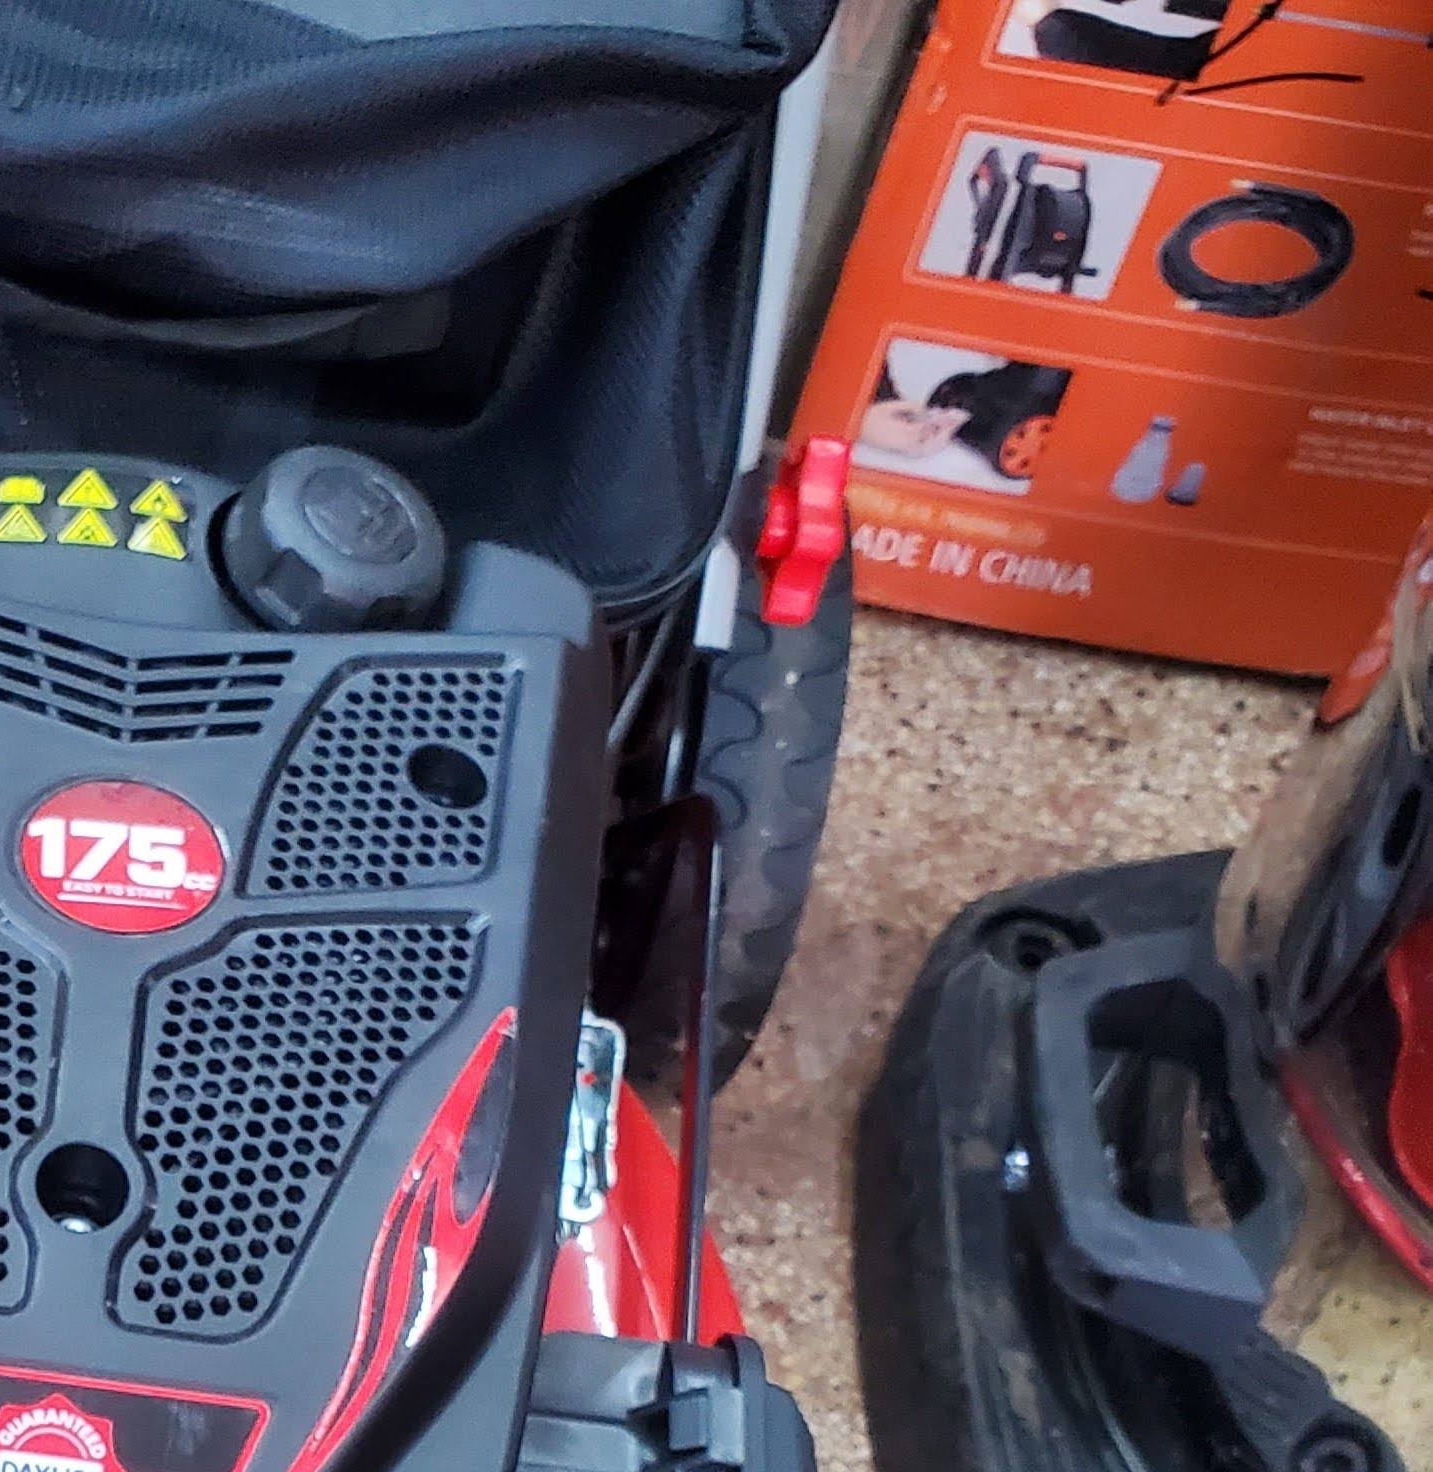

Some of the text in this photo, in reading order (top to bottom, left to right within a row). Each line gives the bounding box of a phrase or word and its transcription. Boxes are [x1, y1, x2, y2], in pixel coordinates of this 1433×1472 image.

[851, 523, 926, 568] ADE
[929, 539, 977, 578] IN
[979, 549, 1093, 599] CHINA
